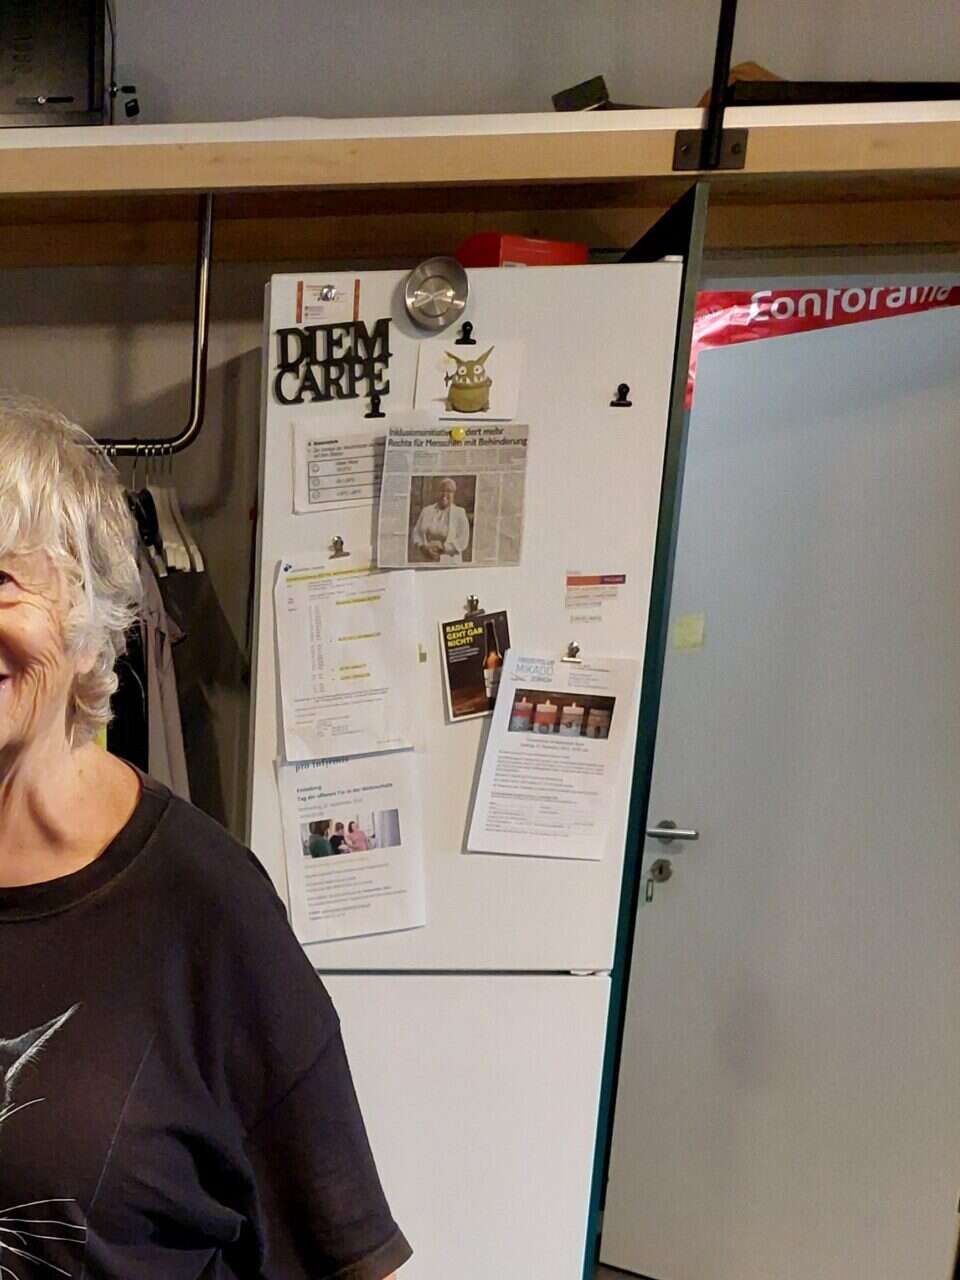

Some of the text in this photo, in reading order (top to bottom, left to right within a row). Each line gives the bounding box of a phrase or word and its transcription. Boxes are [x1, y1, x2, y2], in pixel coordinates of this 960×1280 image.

[276, 317, 392, 369] DIEM
[274, 360, 390, 405] CARPE
[388, 438, 412, 448] Rechte
[413, 438, 424, 447] für
[464, 437, 477, 447] mit
[478, 436, 529, 448] Behinderung
[446, 621, 475, 633] RADLER
[446, 626, 484, 641] GEHT GAR
[447, 637, 474, 648] NICHT!
